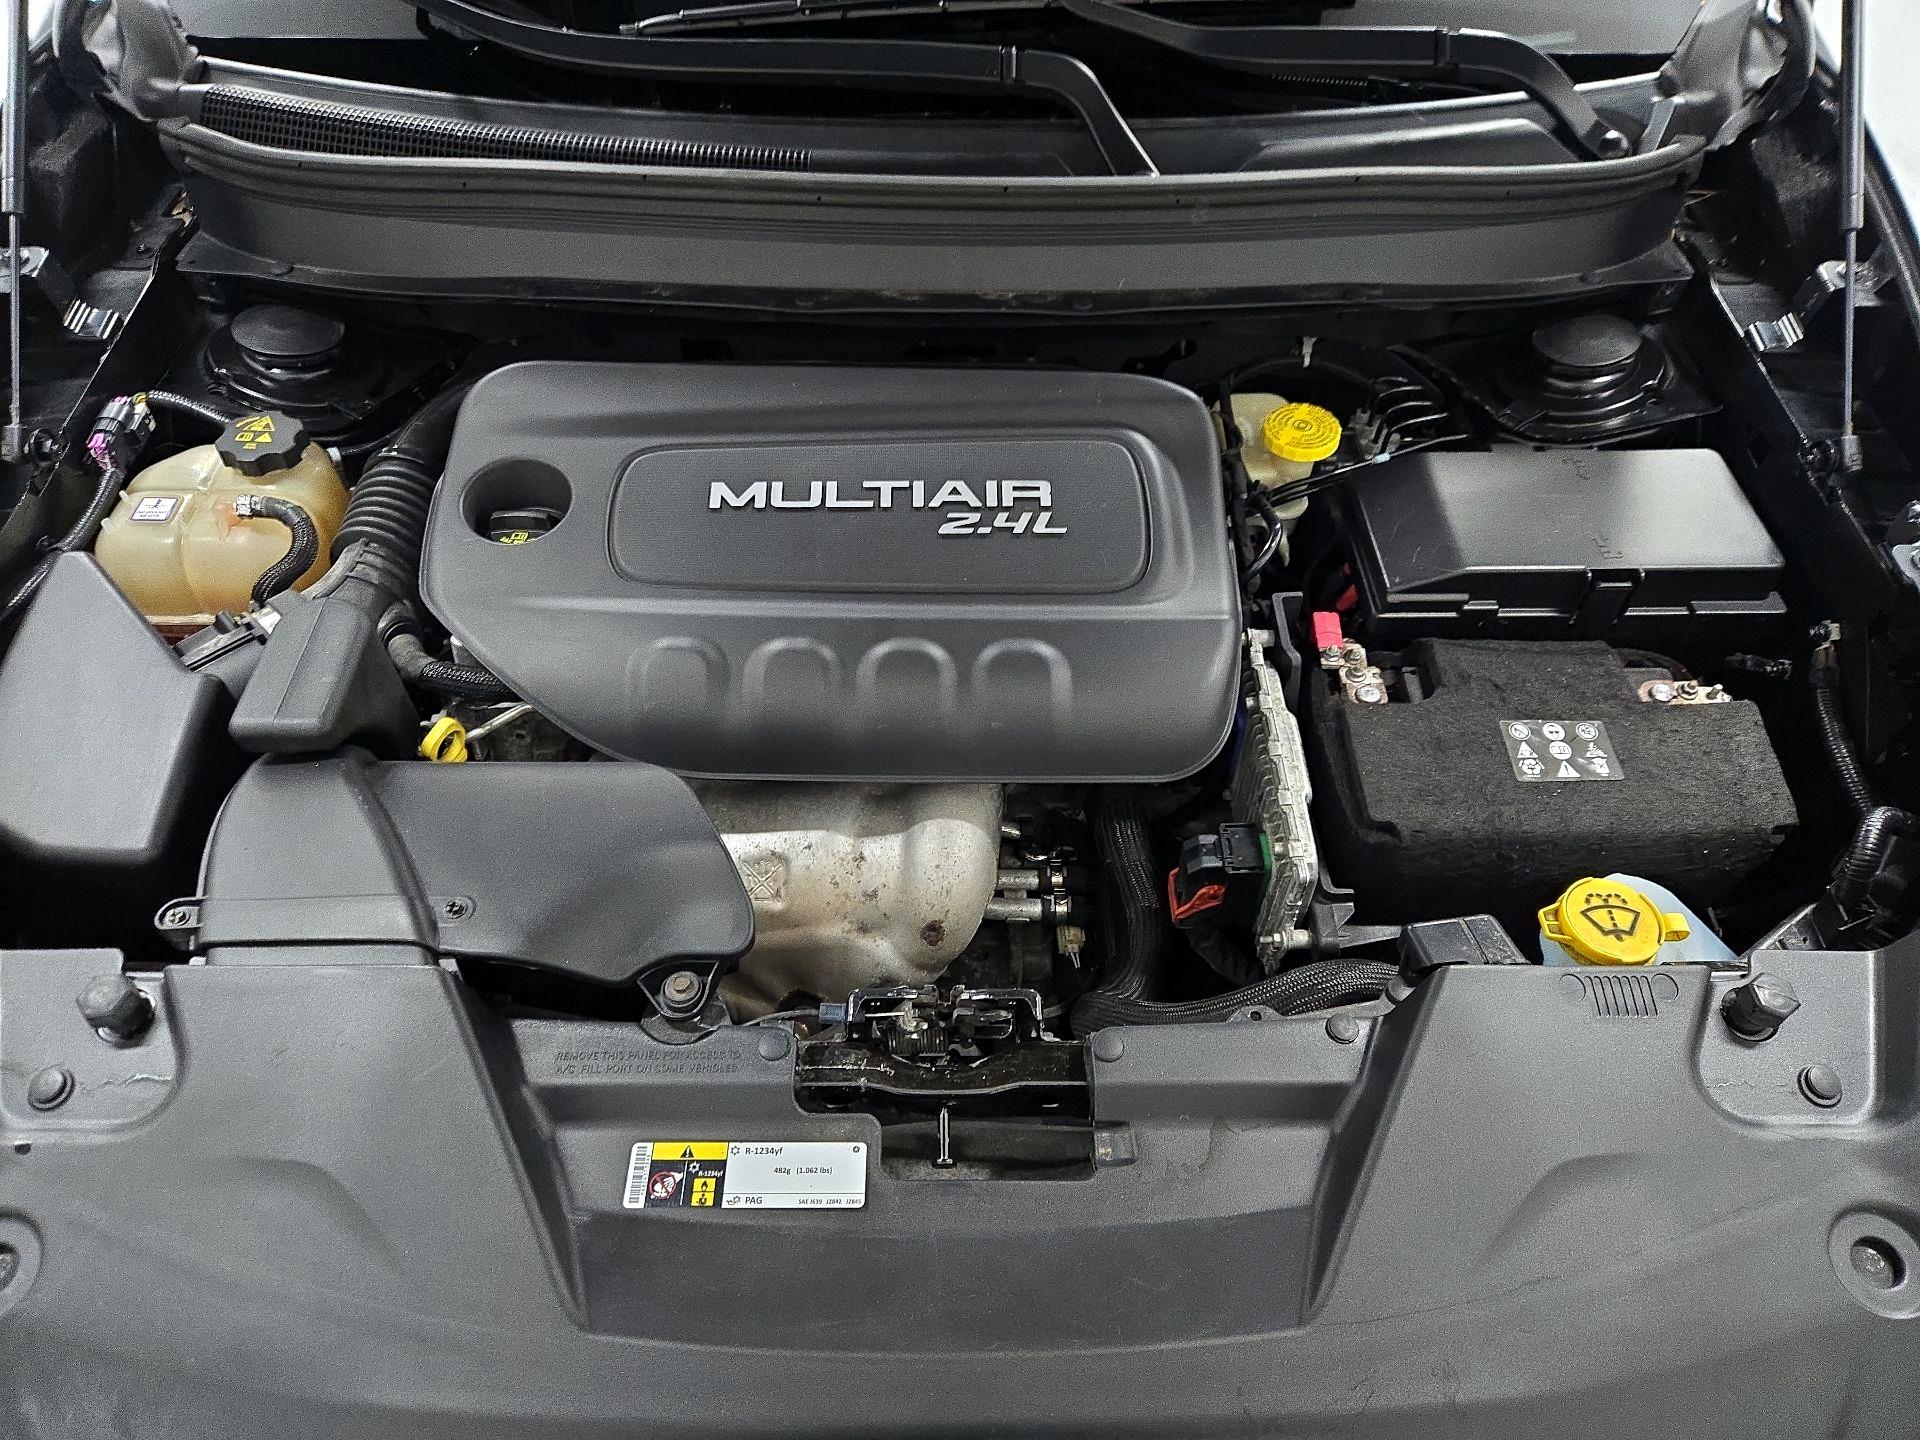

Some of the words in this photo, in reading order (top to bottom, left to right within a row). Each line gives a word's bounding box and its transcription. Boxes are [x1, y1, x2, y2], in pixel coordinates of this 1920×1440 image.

[708, 480, 1052, 509] MULTIAIR
[937, 511, 1068, 535] 2.4L
[556, 1050, 599, 1062] REMOVE
[602, 1050, 625, 1062] THIS
[627, 1050, 660, 1062] PANEL
[580, 1063, 602, 1074] FILL
[605, 1063, 633, 1074] PORT
[745, 1146, 783, 1156] R-1234yf
[773, 1167, 791, 1176] 482g
[796, 1167, 818, 1176] (1.062
[820, 1167, 833, 1176] lbs)
[745, 1196, 763, 1205] PAG
